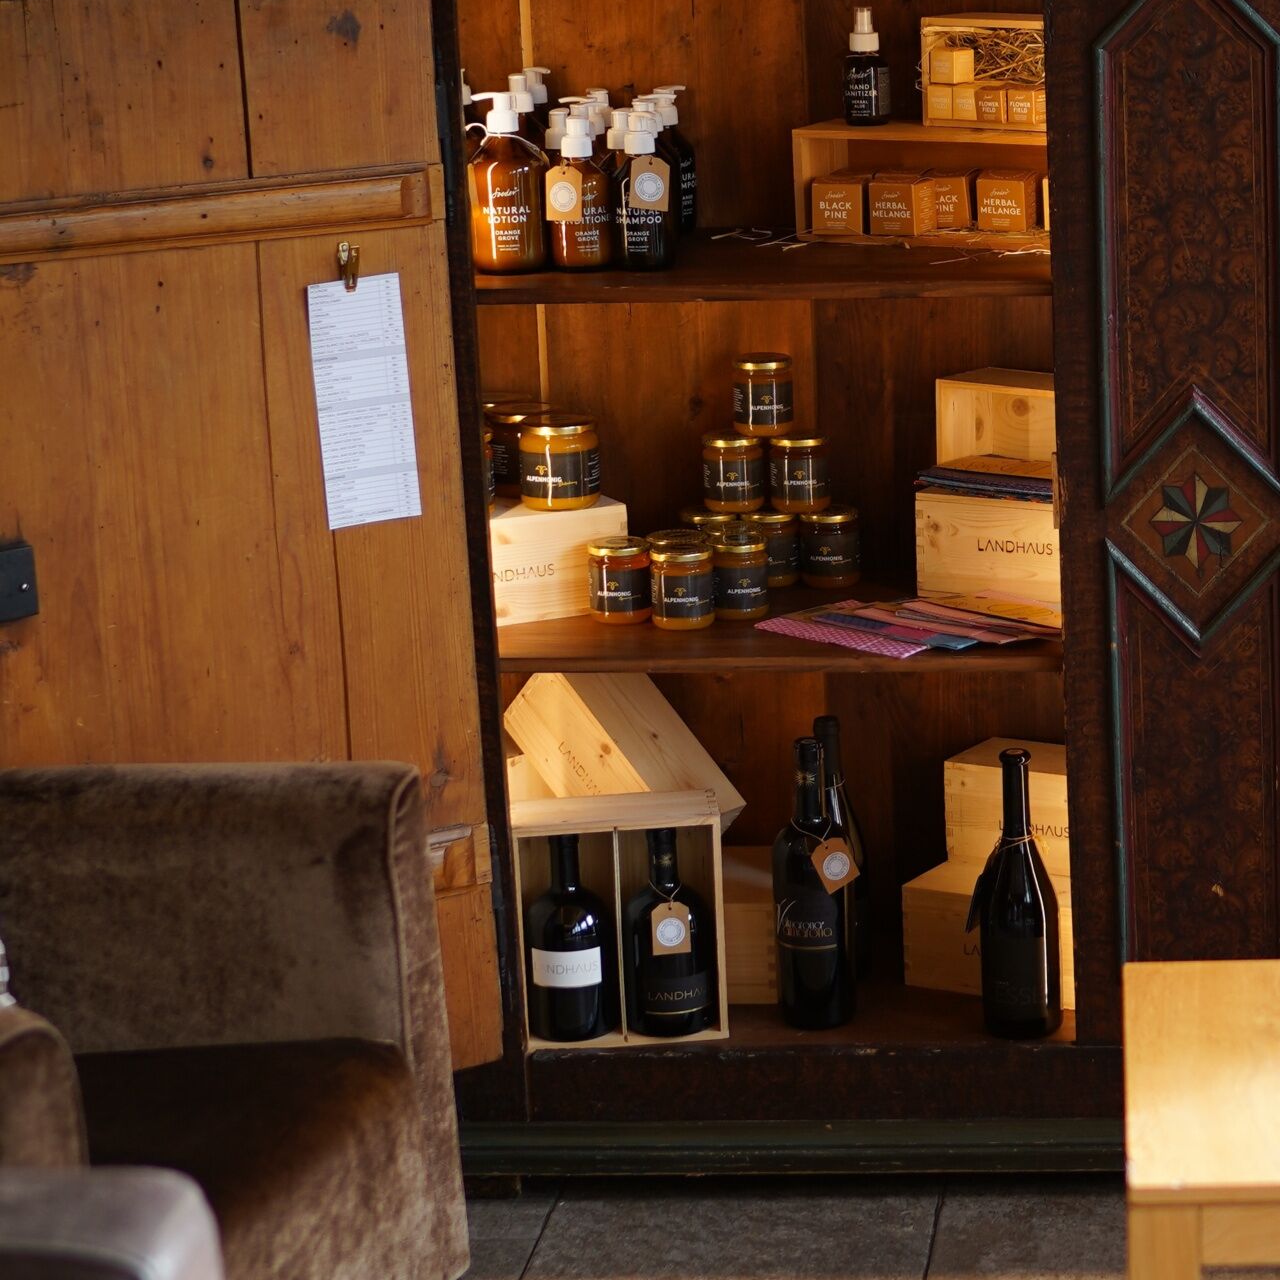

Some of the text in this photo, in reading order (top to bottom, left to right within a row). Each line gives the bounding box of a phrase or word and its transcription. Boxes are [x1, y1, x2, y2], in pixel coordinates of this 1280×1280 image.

[935, 195, 958, 205] LACK
[983, 198, 1017, 208] HERBAL
[482, 205, 531, 215] NATURAL
[819, 201, 852, 211] BLACK
[875, 201, 908, 211] HERBAL
[980, 206, 1022, 216] MELANGE
[488, 215, 527, 224] LOTION
[824, 210, 847, 220] PINE
[872, 210, 912, 219] MELANGE
[977, 538, 1054, 556] LANDHAUS
[494, 563, 555, 583] NDHAUS
[999, 820, 1070, 839] LDHAUS
[534, 959, 599, 977] NDHAUS
[647, 986, 705, 1001] LANDHA
